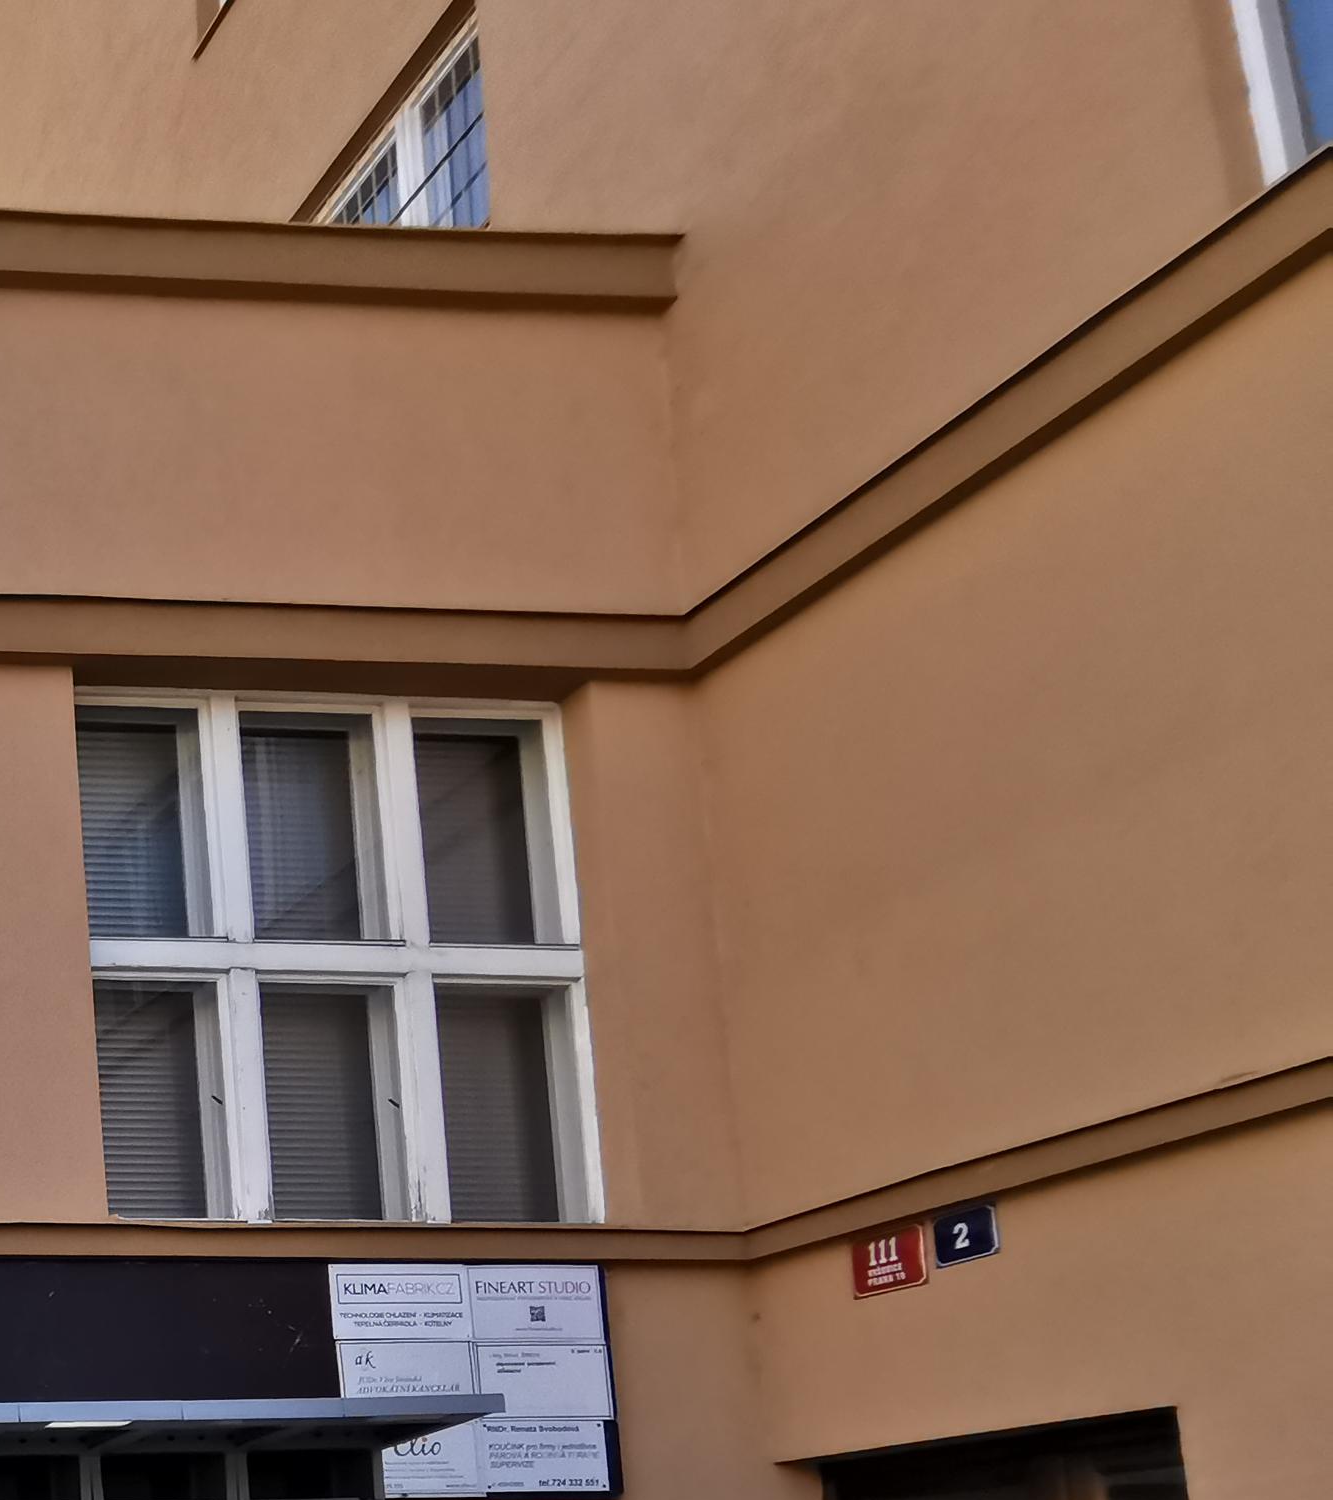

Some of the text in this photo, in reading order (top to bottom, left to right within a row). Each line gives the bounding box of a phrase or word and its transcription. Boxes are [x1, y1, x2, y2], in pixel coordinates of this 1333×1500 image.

[952, 1222, 970, 1249] 2
[868, 1236, 898, 1266] 111
[475, 1281, 591, 1294] FINEART STUDIO
